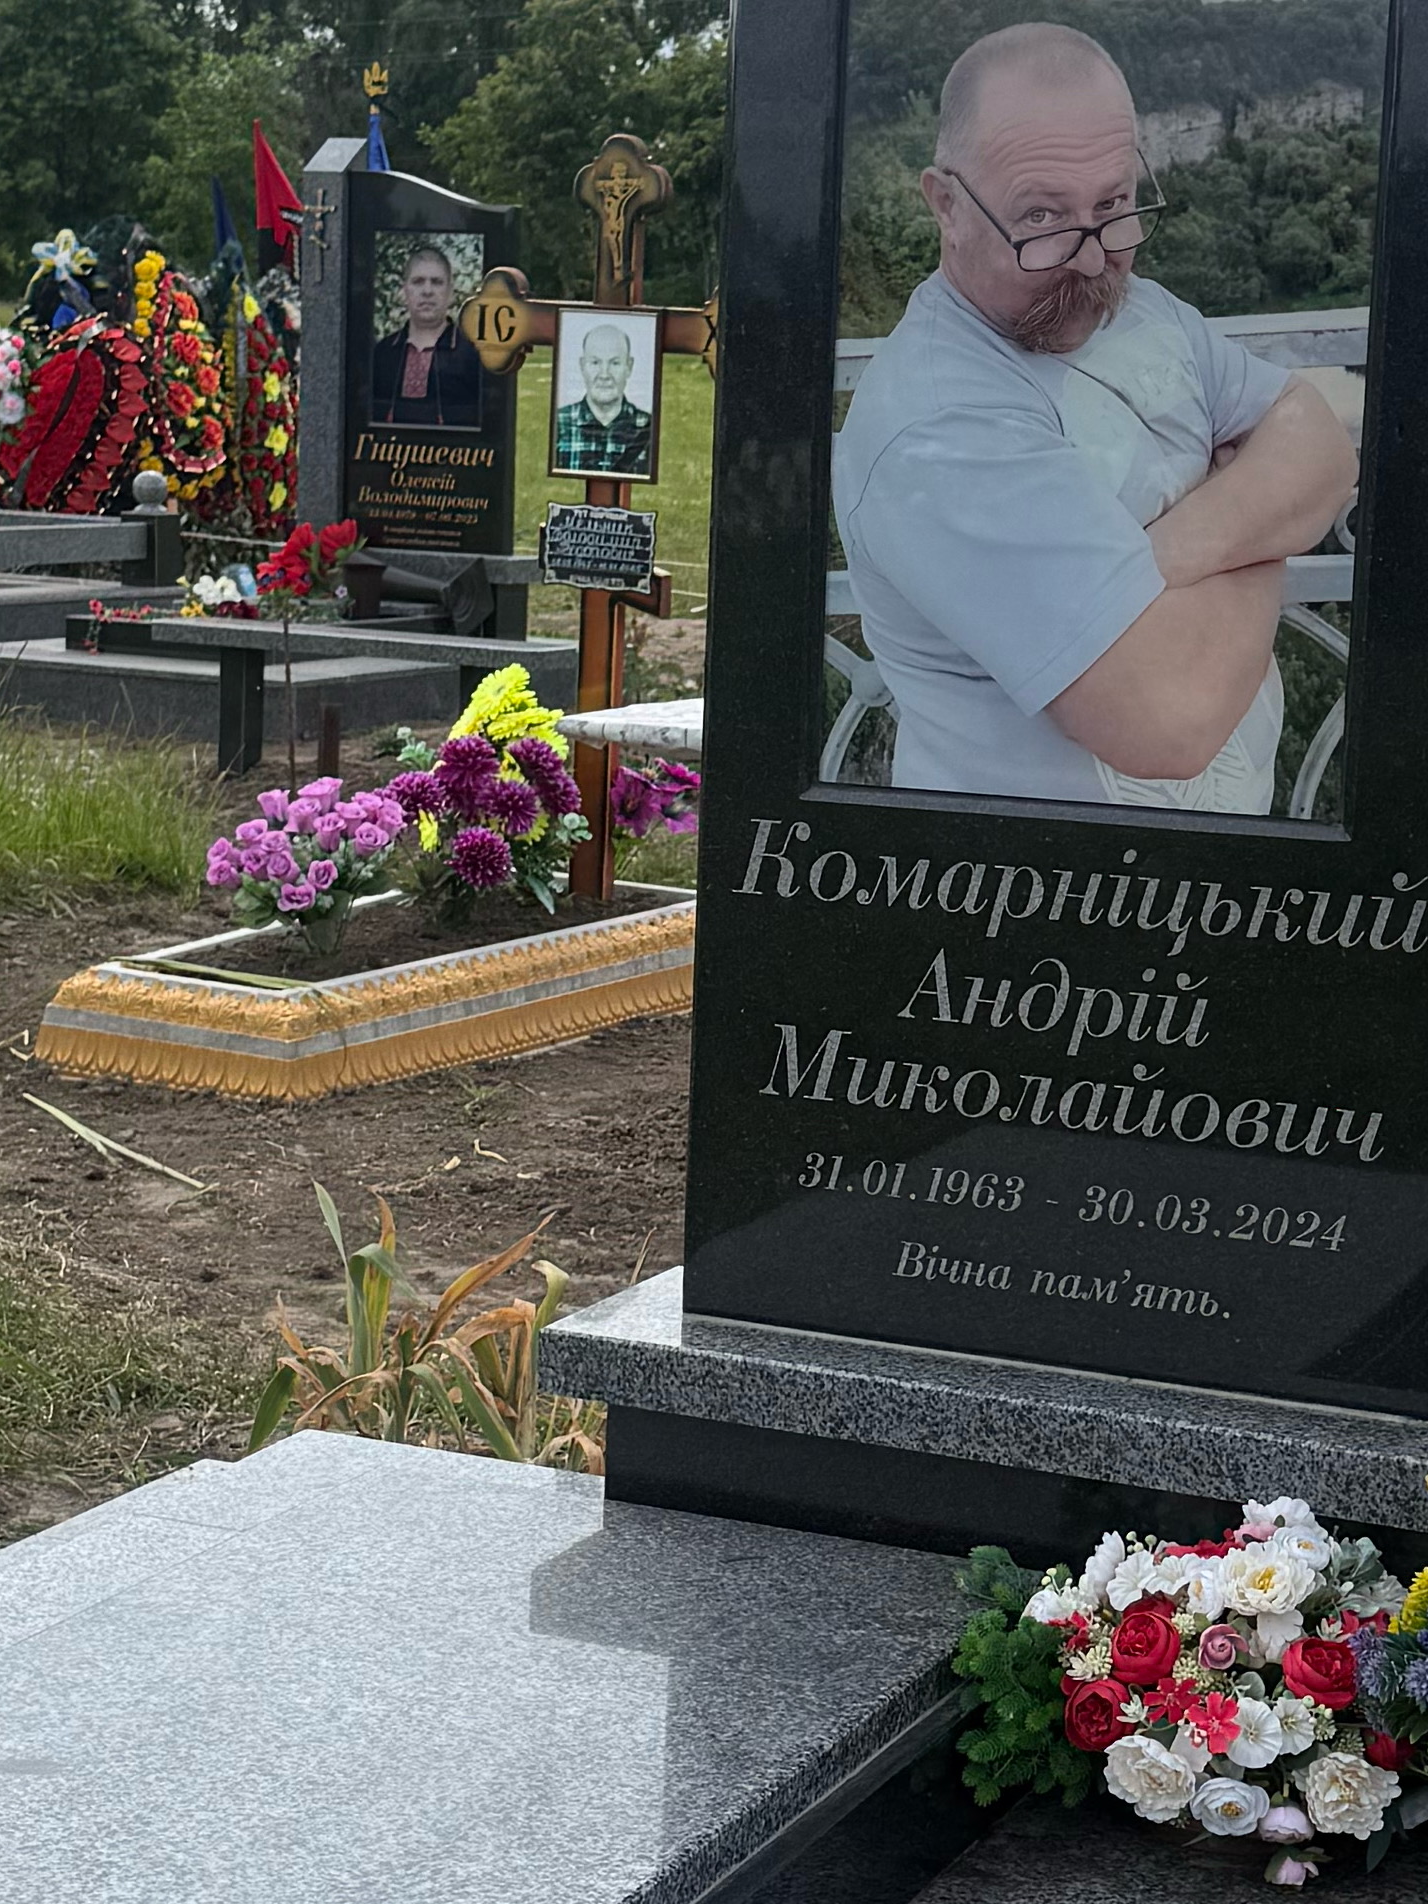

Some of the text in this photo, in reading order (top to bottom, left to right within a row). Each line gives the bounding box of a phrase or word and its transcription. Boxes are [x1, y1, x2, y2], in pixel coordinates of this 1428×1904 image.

[358, 485, 489, 511] Володимирович
[390, 469, 456, 491] Олексій
[732, 818, 1428, 957] Комарніцький
[897, 948, 1210, 1056] Андрій
[759, 1024, 1384, 1162] Миколайович
[798, 1152, 1025, 1212] 31.01.1963
[1078, 1185, 1347, 1252] 30.03.2024
[892, 1241, 1012, 1291] Вічна
